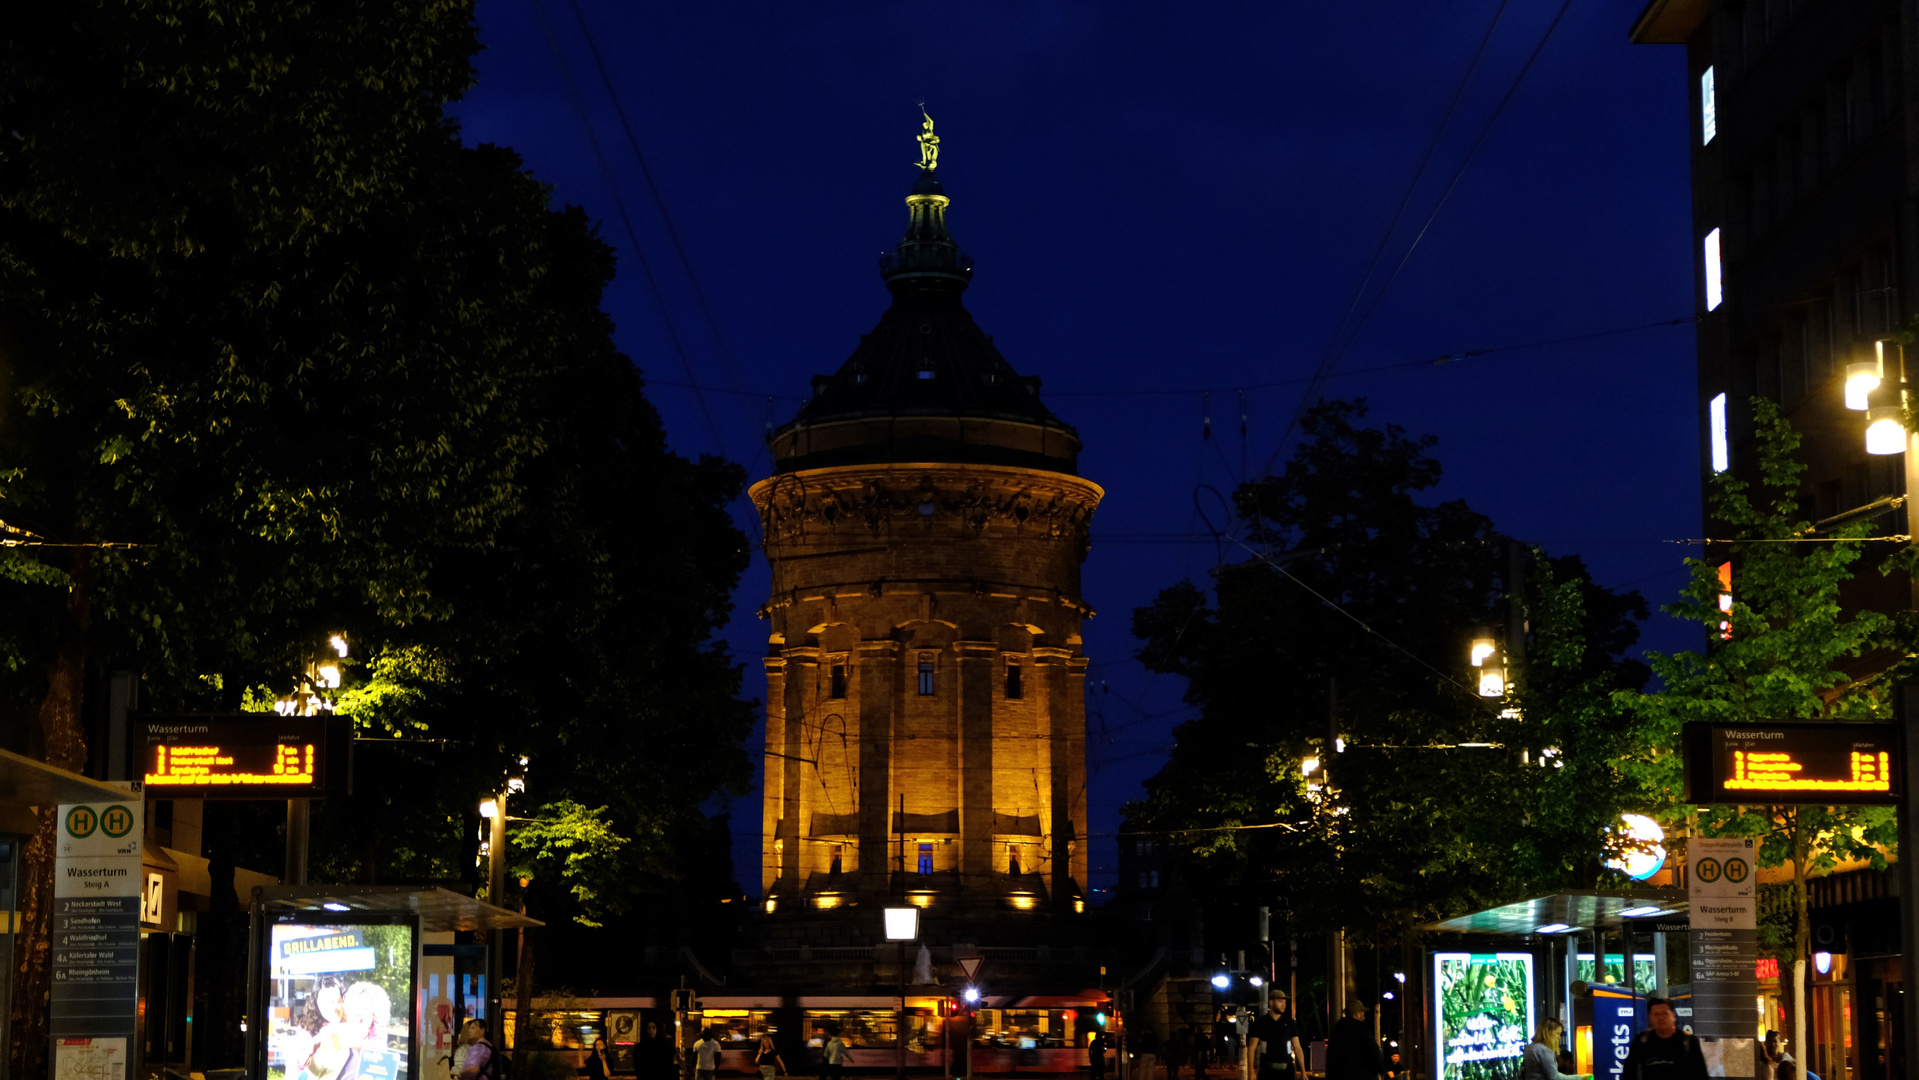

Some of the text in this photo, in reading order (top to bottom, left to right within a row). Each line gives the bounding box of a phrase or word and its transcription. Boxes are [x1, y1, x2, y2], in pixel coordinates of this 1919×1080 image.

[148, 725, 208, 733] Wasserturm
[1725, 730, 1785, 739] Wasserturm
[67, 867, 127, 877] Wasserturm
[84, 881, 102, 889] Steig
[64, 902, 70, 912] 2
[1700, 905, 1747, 914] Wasserturm
[63, 919, 69, 929] 3
[62, 936, 68, 946] 4
[1699, 932, 1704, 940] 2
[56, 953, 67, 963] 4A
[55, 970, 67, 980] 6A
